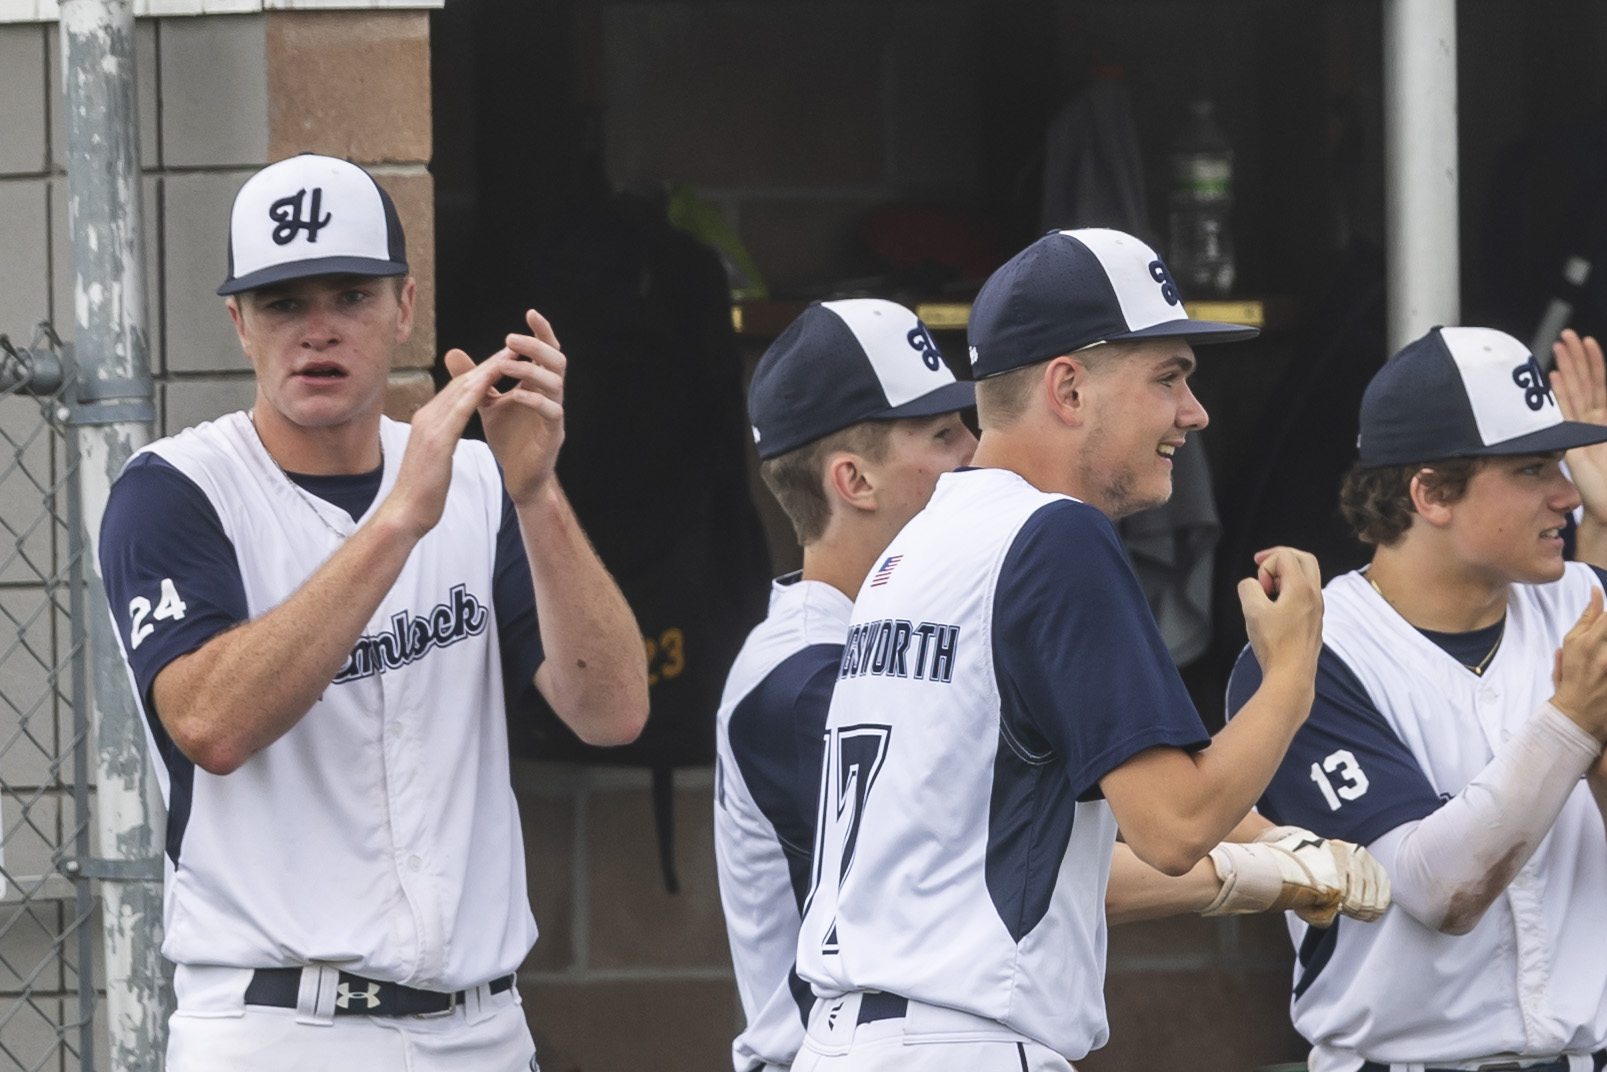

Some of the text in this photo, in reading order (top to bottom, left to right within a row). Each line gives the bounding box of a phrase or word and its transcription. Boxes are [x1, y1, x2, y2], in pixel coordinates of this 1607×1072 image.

[269, 187, 332, 246] H
[129, 577, 187, 650] 24
[331, 582, 489, 685] mlock
[1310, 748, 1370, 811] 13
